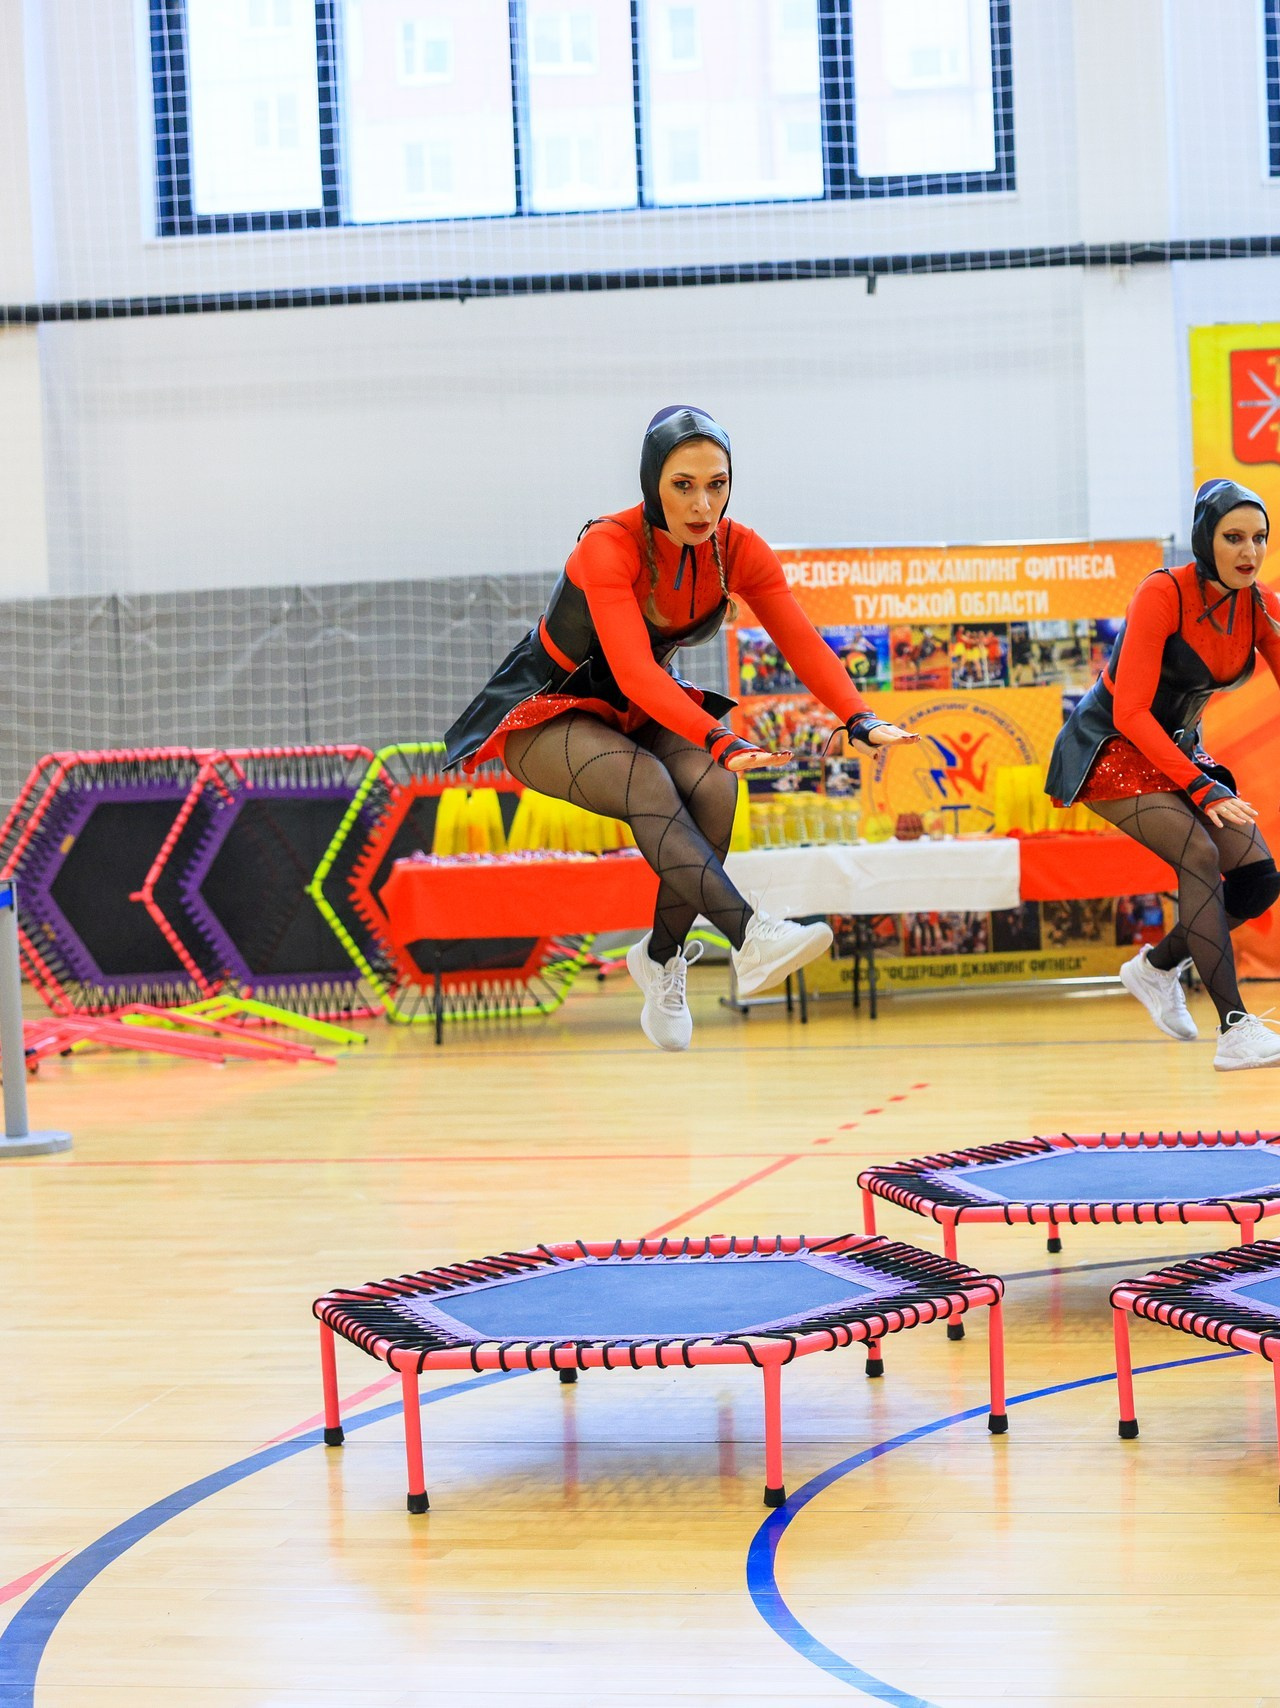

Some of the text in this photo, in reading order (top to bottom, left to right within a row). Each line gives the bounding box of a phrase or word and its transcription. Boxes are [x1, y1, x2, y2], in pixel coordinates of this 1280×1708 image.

[781, 553, 1116, 589] ФЕДЕРАЦИЯ ДЖАМПИНГ ФИТНЕСА
[852, 588, 1049, 620] ТУЛЬСКОЙ ОБЛАСТИ
